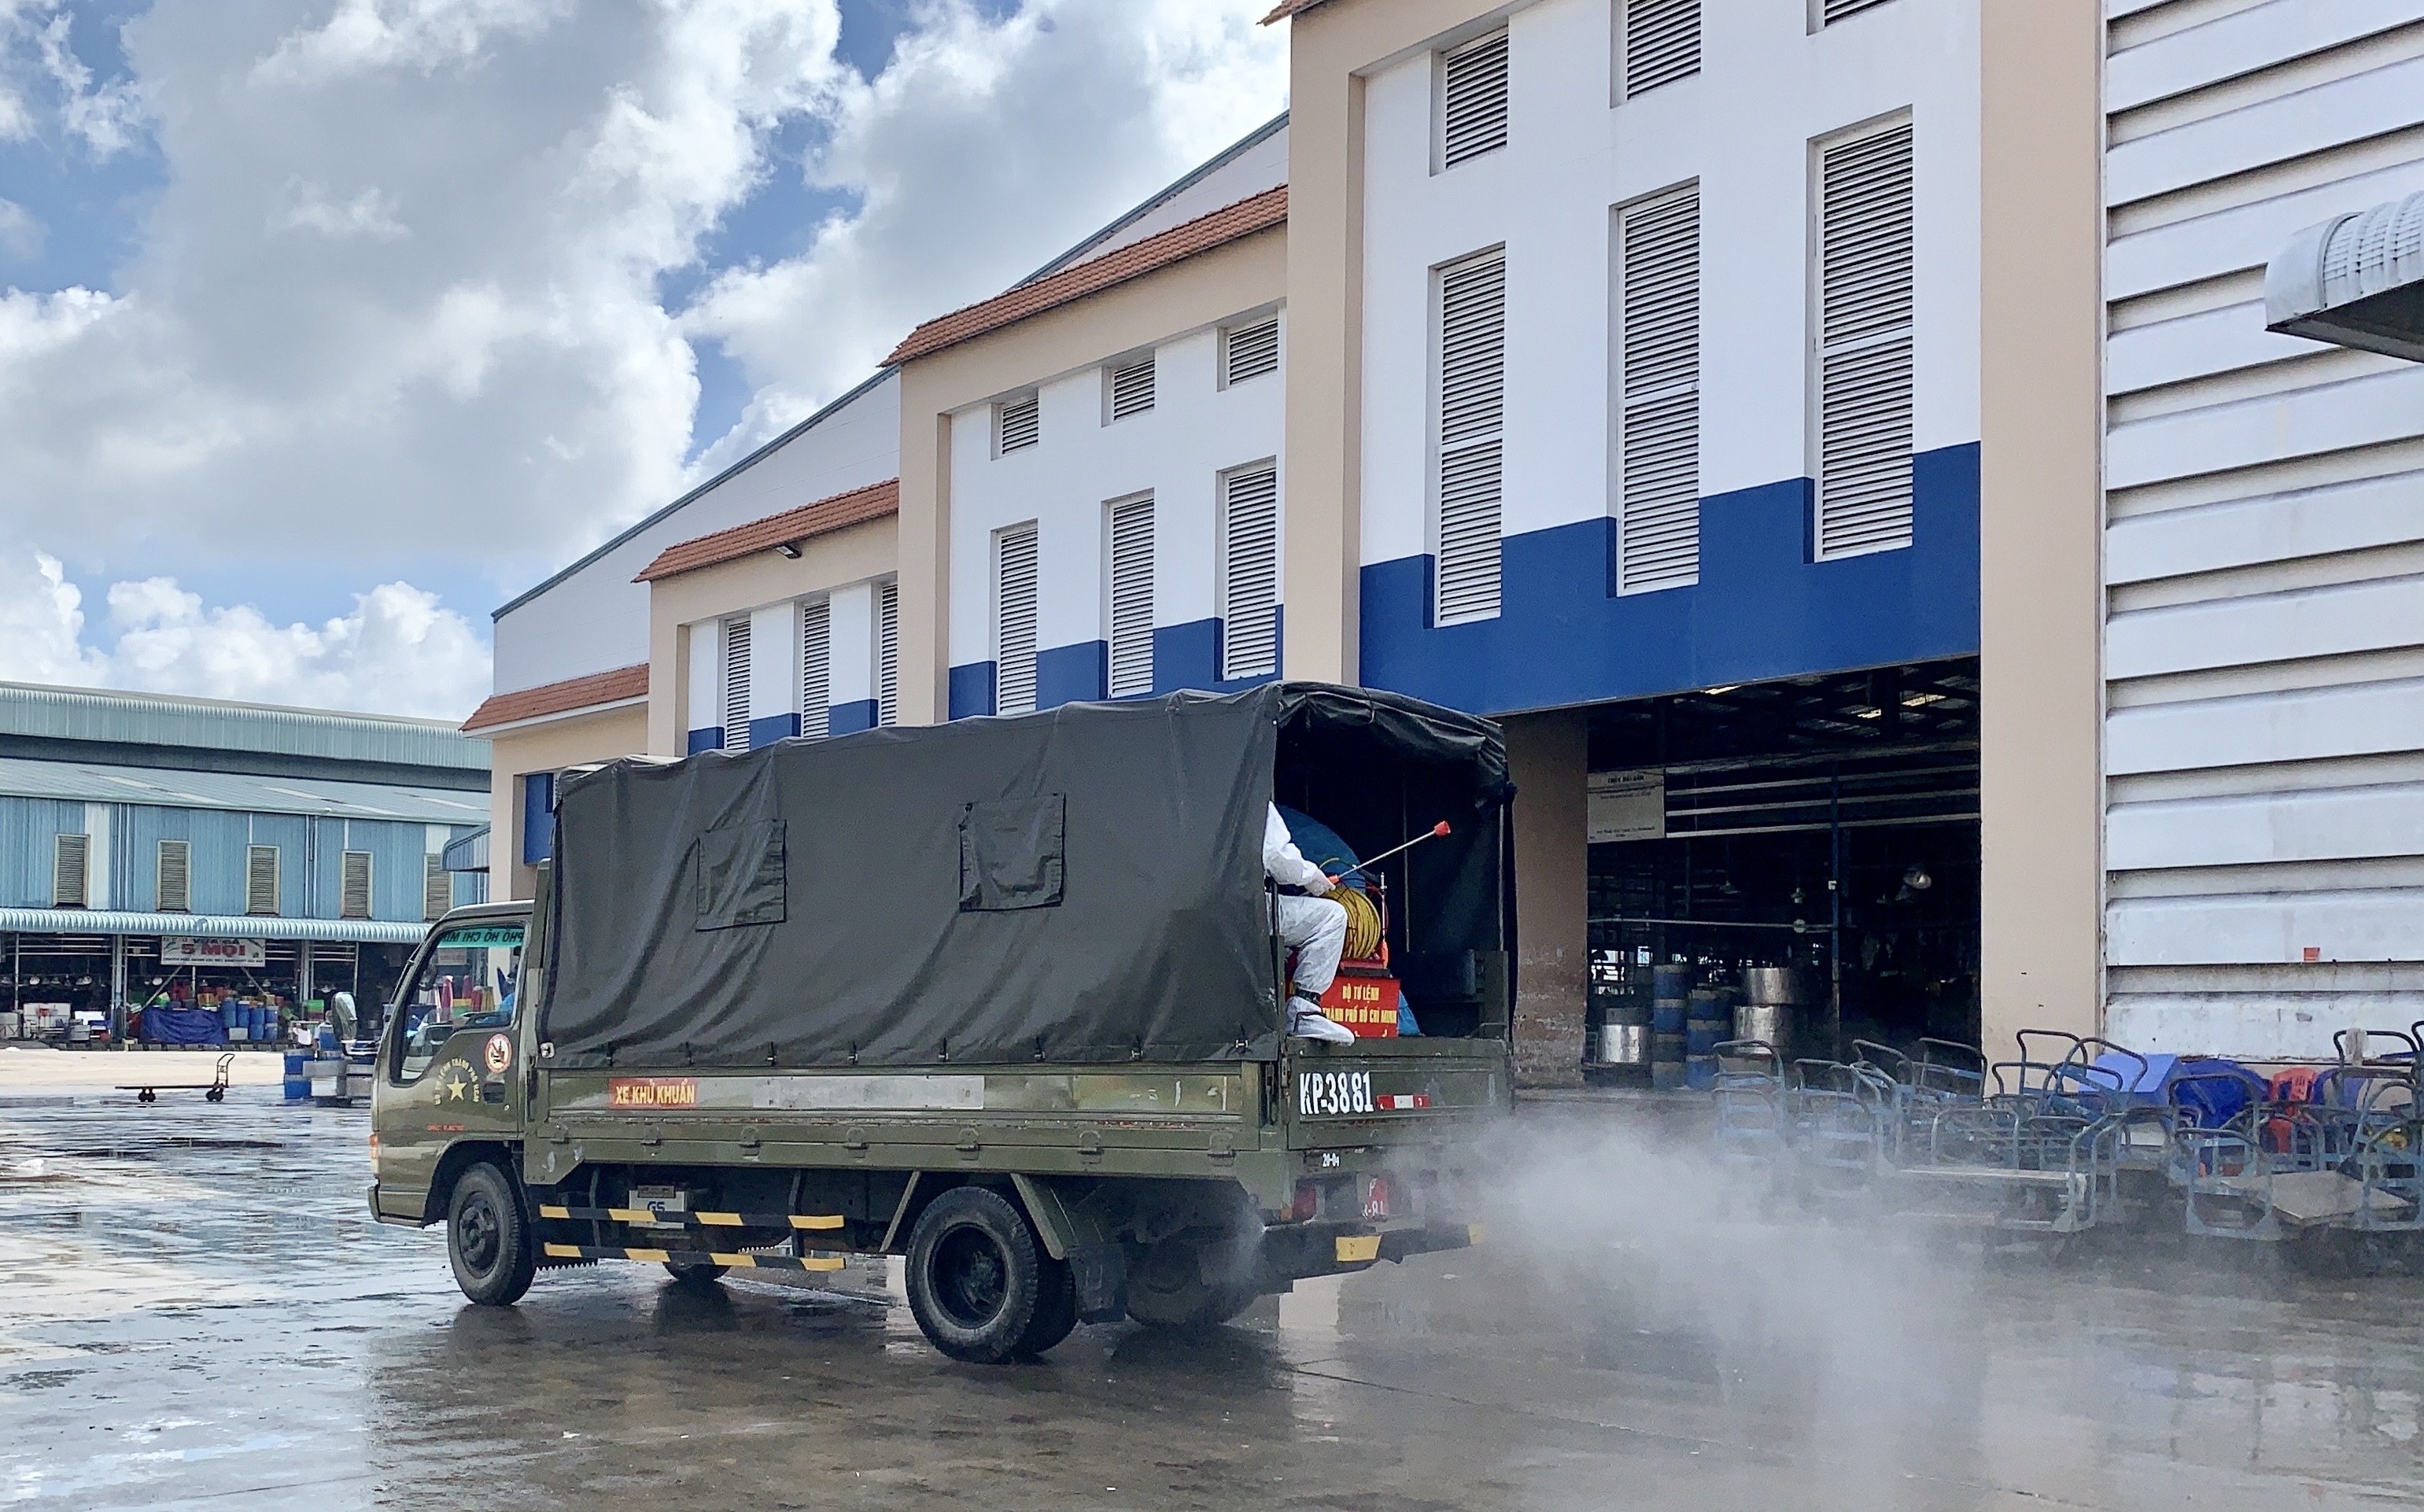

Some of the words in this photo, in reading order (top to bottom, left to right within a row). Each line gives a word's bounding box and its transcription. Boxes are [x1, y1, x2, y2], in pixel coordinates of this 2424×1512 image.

[615, 1086, 629, 1104] XE
[656, 1079, 695, 1104] KHUẨN
[1300, 1071, 1374, 1115] KP-3881
